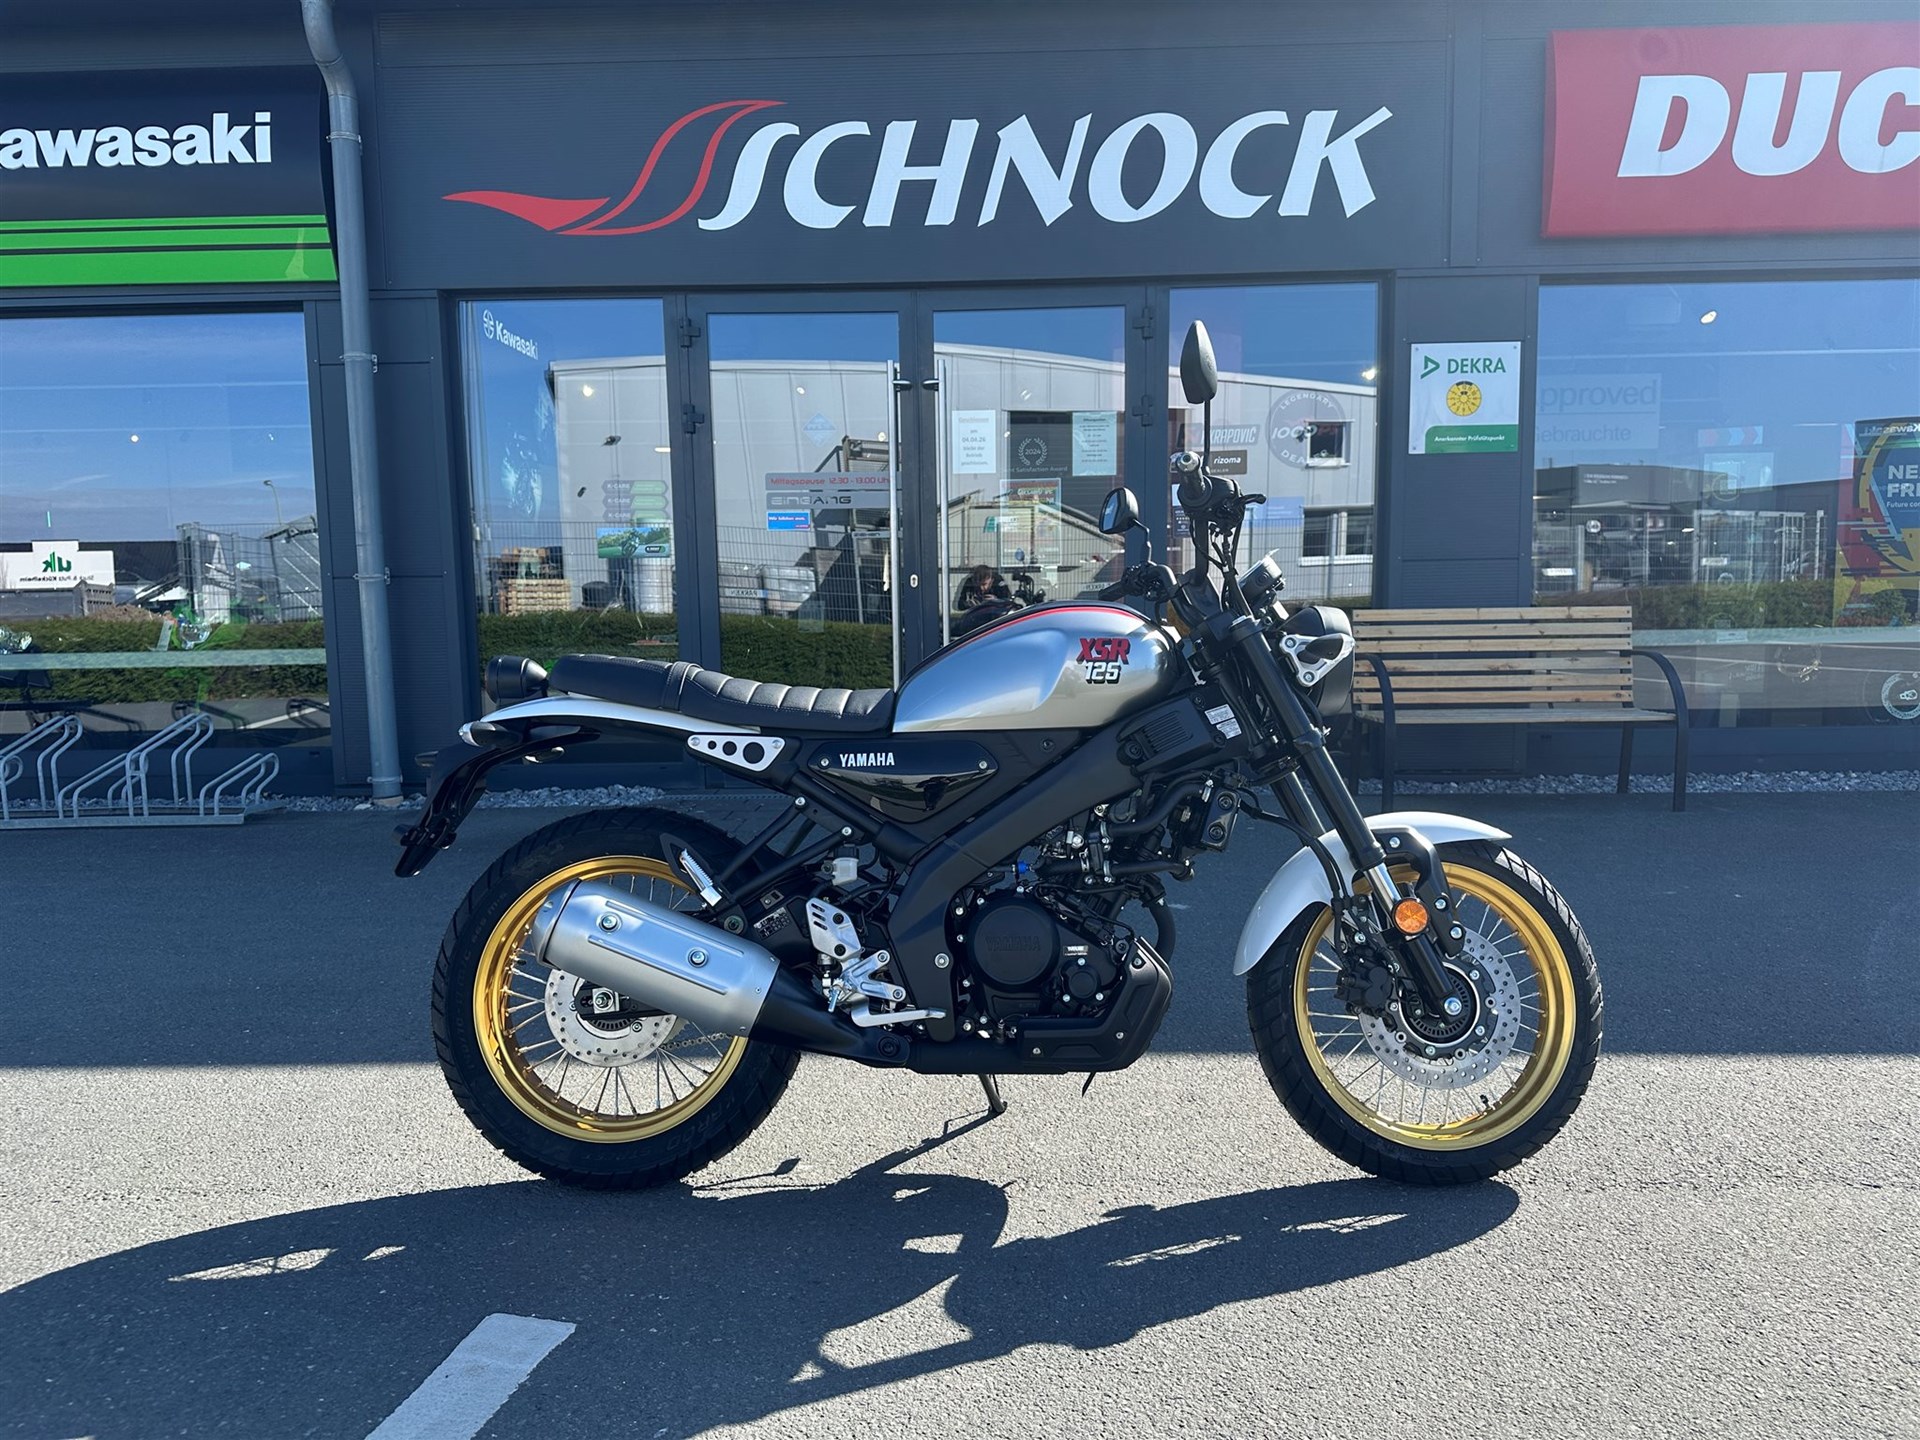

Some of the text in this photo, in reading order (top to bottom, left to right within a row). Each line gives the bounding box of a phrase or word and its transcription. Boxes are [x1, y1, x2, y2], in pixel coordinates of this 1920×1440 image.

[0, 112, 271, 170] awasaki
[698, 106, 1393, 230] SCHNOCK
[496, 320, 538, 360] Kawasaki
[1448, 357, 1506, 374] DEKRA
[1280, 393, 1334, 410] LEGENDARY
[1538, 379, 1657, 412] pproved
[1214, 456, 1241, 464] rizoma
[1888, 465, 1920, 480] NE
[1076, 637, 1131, 665] XSR
[1085, 661, 1121, 684] 125
[840, 752, 895, 767] YAMAHA
[985, 935, 1040, 951] YAMAHA
